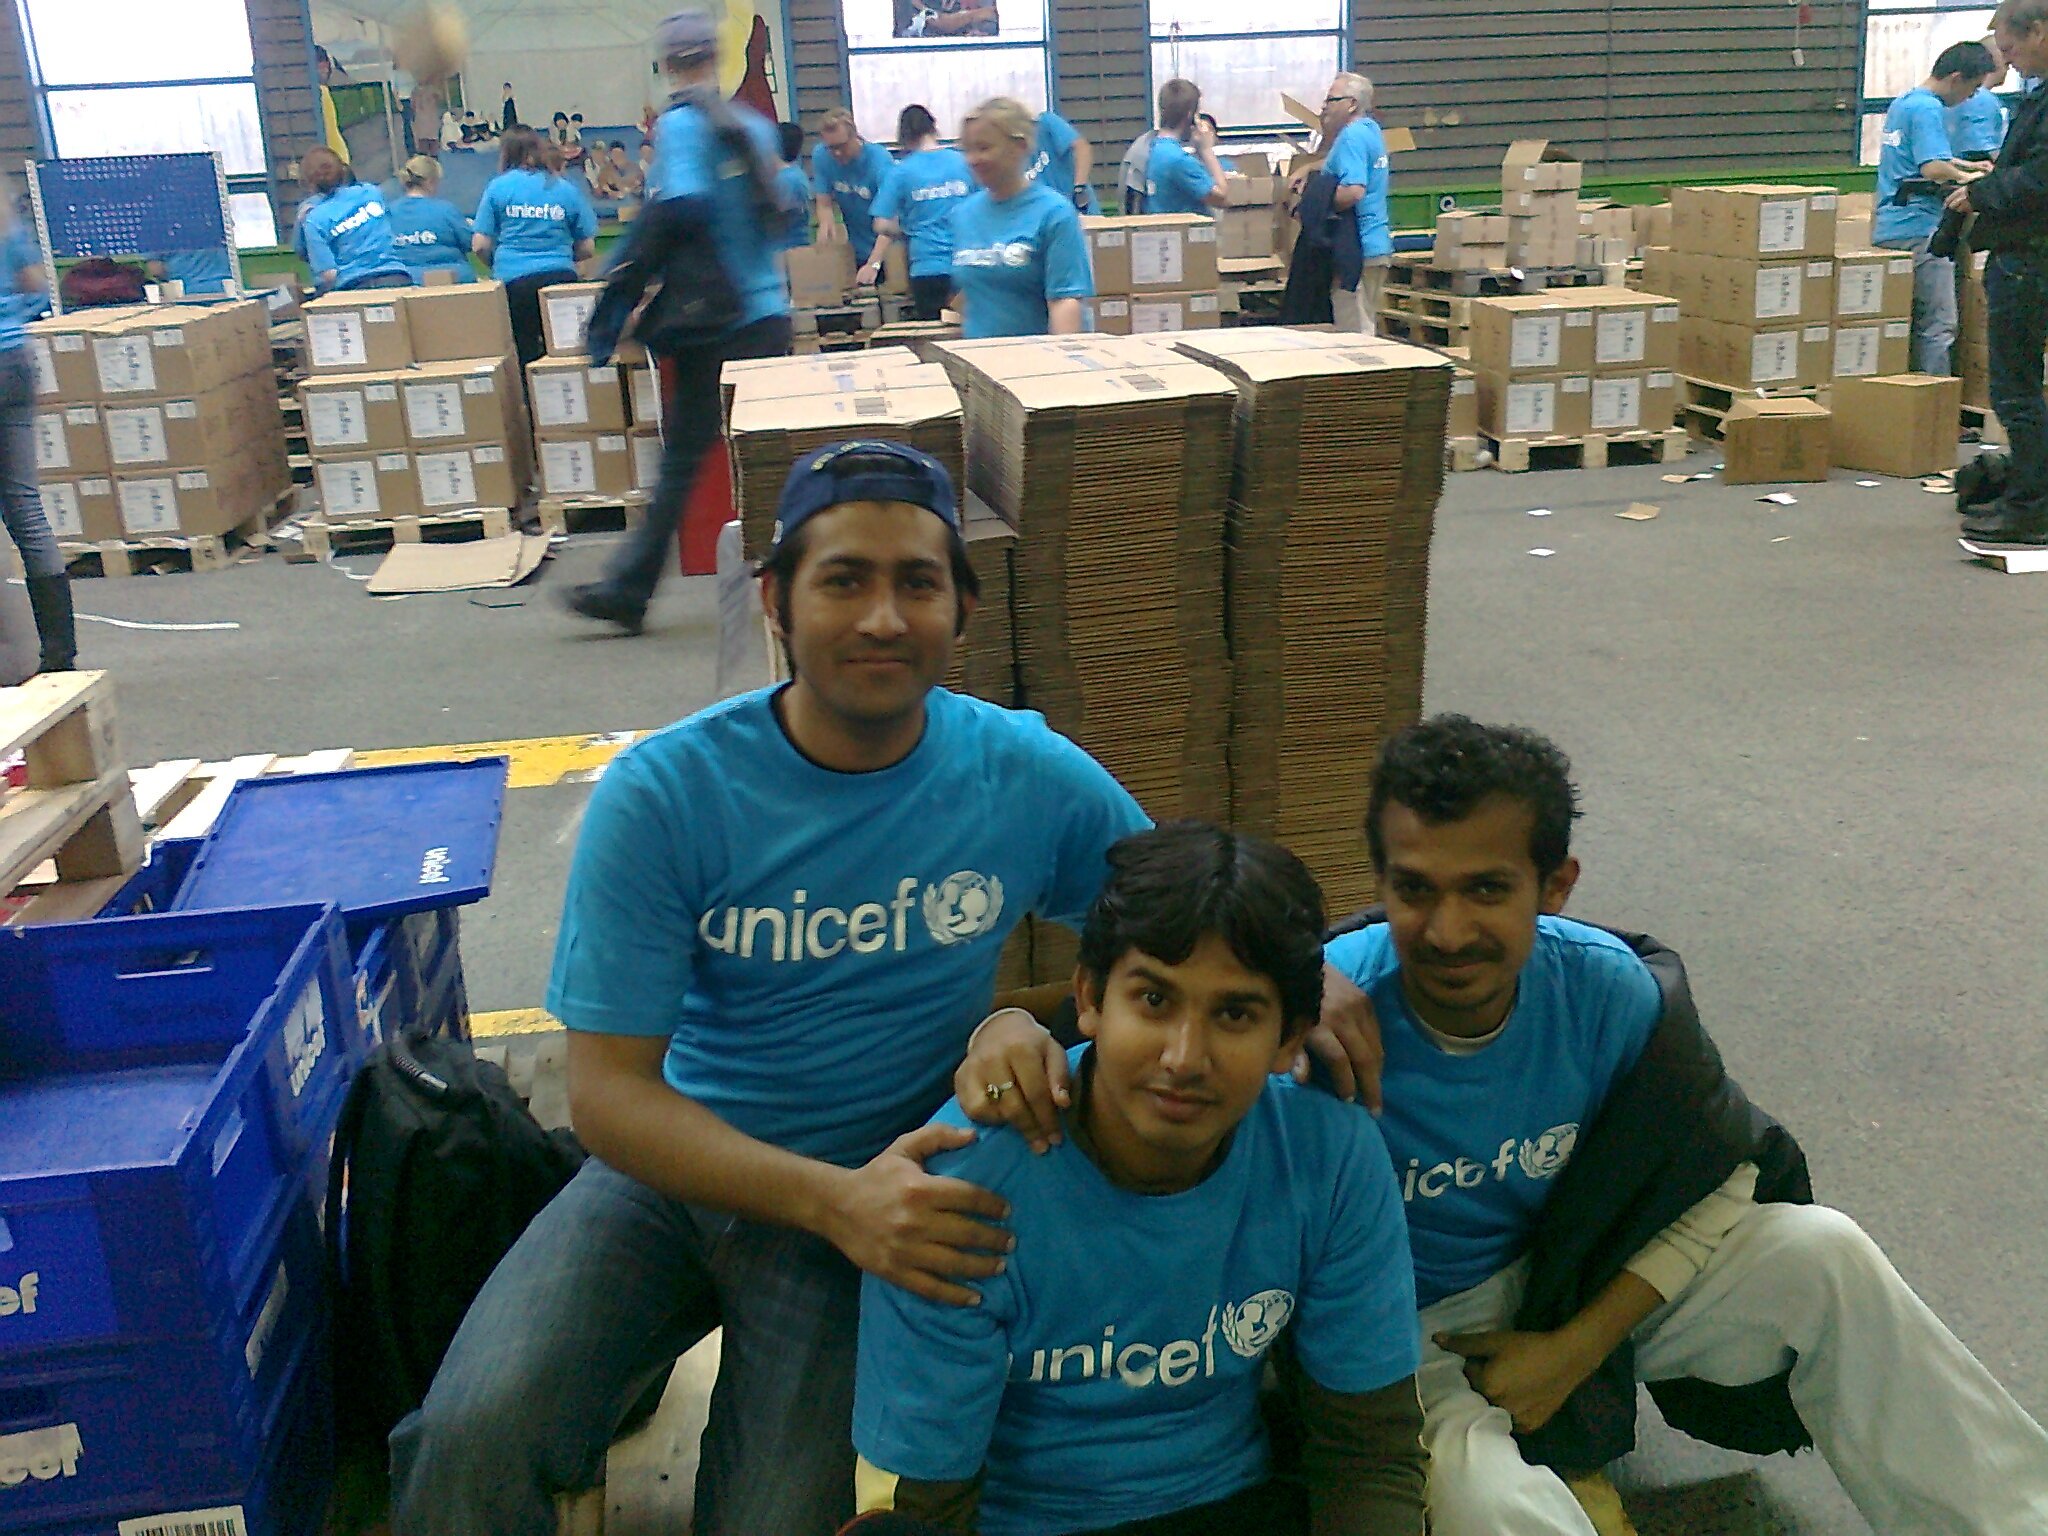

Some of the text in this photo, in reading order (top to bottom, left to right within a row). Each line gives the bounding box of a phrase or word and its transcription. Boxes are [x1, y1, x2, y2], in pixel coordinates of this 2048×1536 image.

[505, 203, 549, 221] unicef
[698, 877, 919, 962] unicef
[1403, 1138, 1516, 1202] icef
